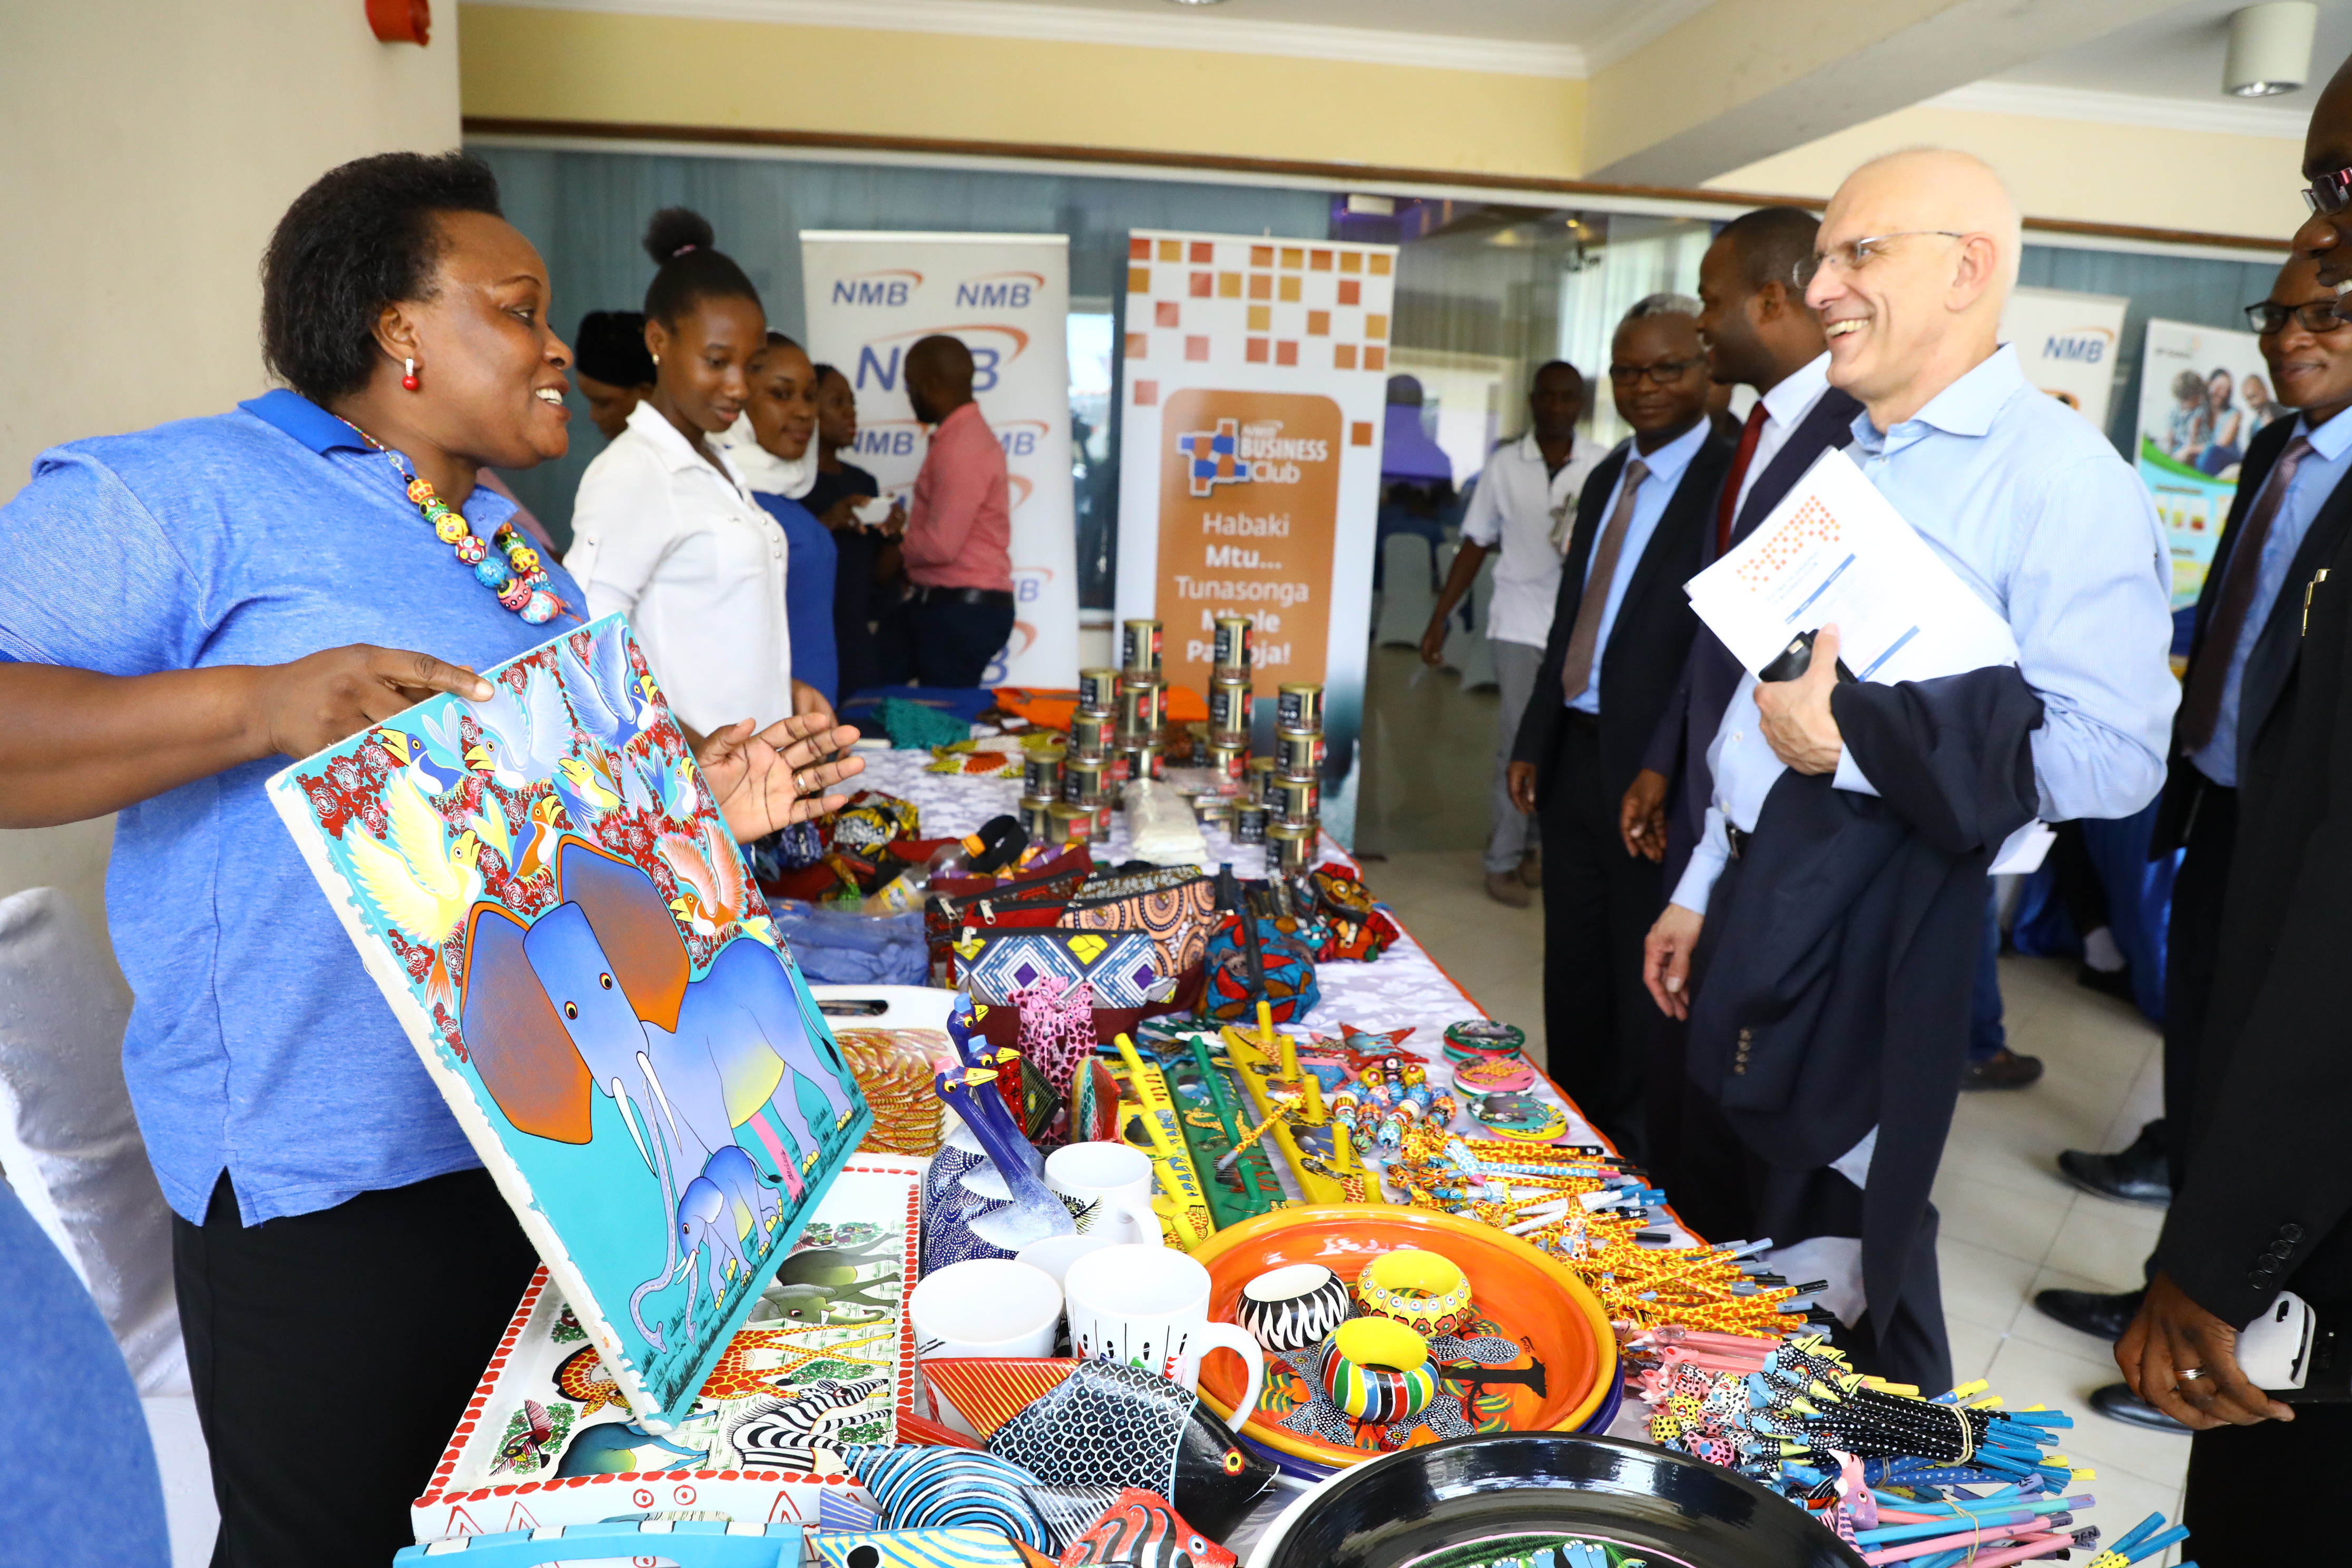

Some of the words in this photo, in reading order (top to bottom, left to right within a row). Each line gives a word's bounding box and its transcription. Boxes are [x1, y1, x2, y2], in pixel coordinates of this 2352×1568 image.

[832, 280, 909, 306] NMB
[955, 283, 1031, 308] NMB
[2043, 336, 2103, 363] NMB
[856, 345, 1000, 391] NB
[1240, 437, 1328, 462] BUSINESS
[1252, 460, 1301, 484] Club
[1202, 511, 1290, 537] Habaki
[1205, 544, 1282, 570] Mtu...
[1174, 575, 1310, 608] Tunasonga
[1187, 640, 1291, 670] Paoja!
